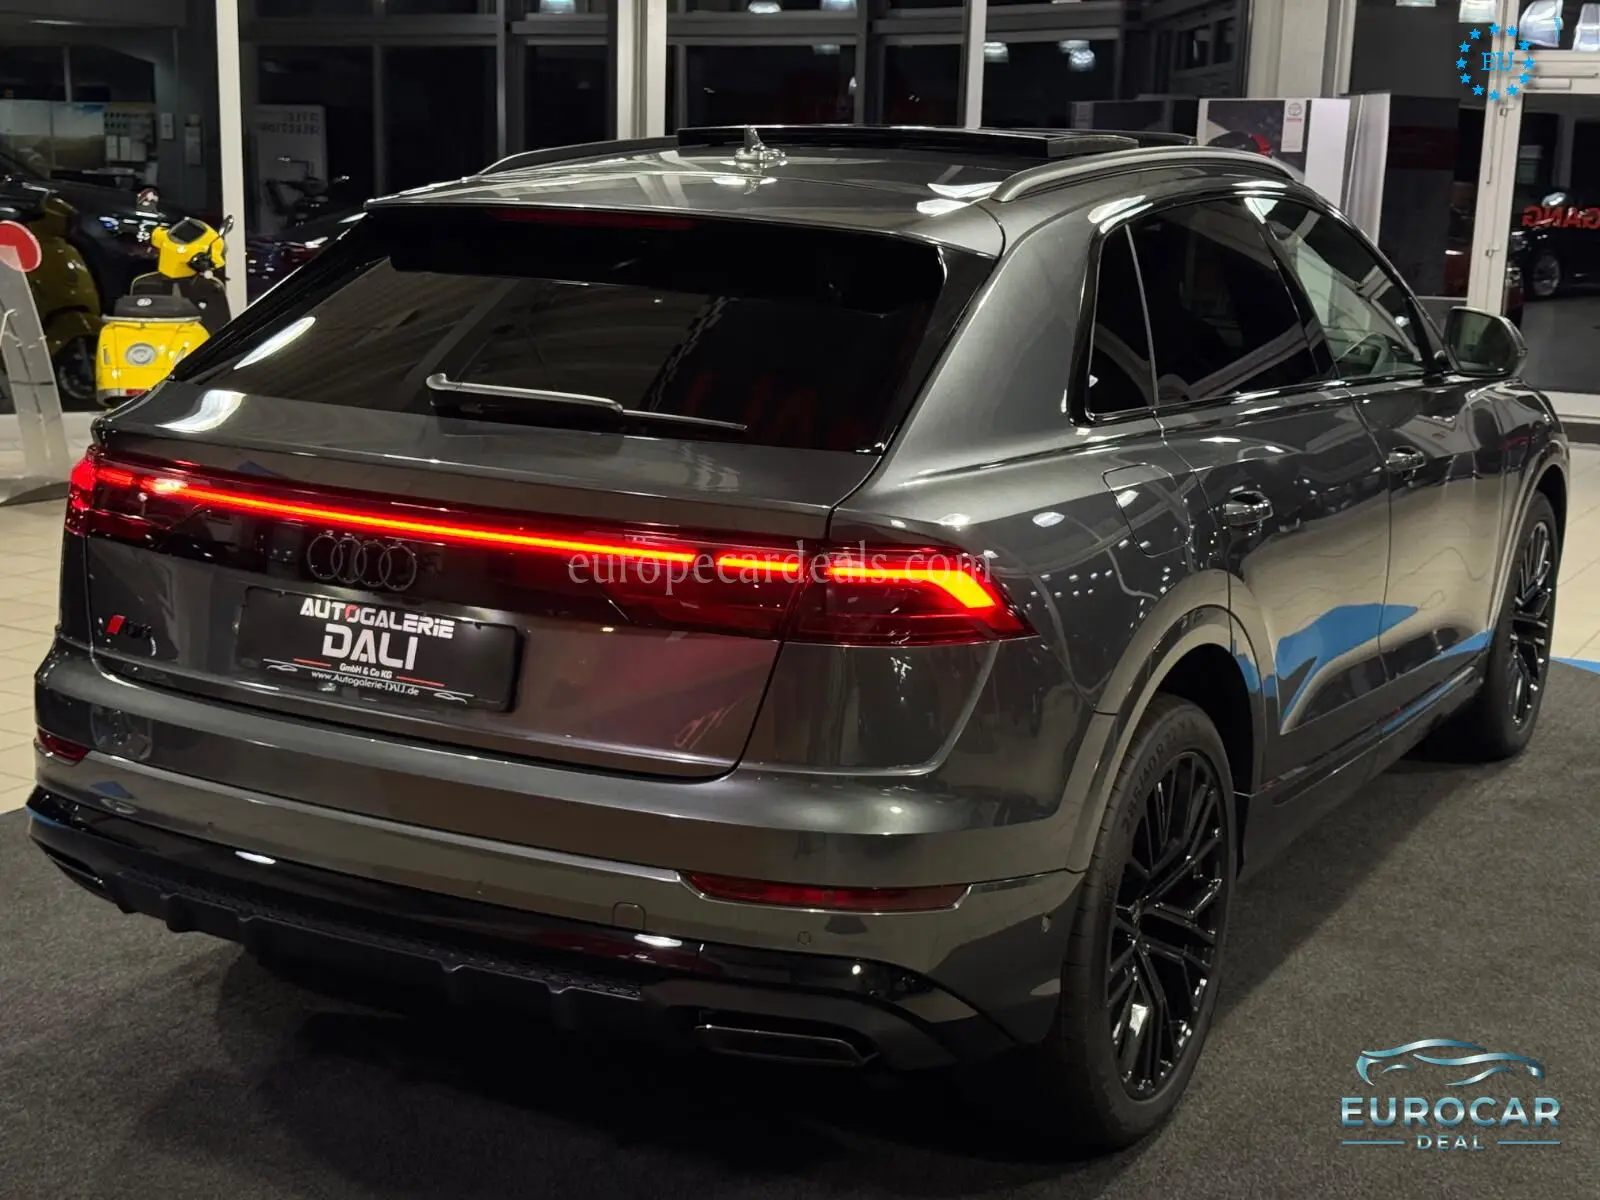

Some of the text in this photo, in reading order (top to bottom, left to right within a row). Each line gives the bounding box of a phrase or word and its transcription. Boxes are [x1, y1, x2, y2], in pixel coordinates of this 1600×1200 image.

[322, 623, 419, 671] DALI
[339, 662, 362, 674] GmbH
[362, 666, 369, 676] &
[380, 669, 393, 679] KG
